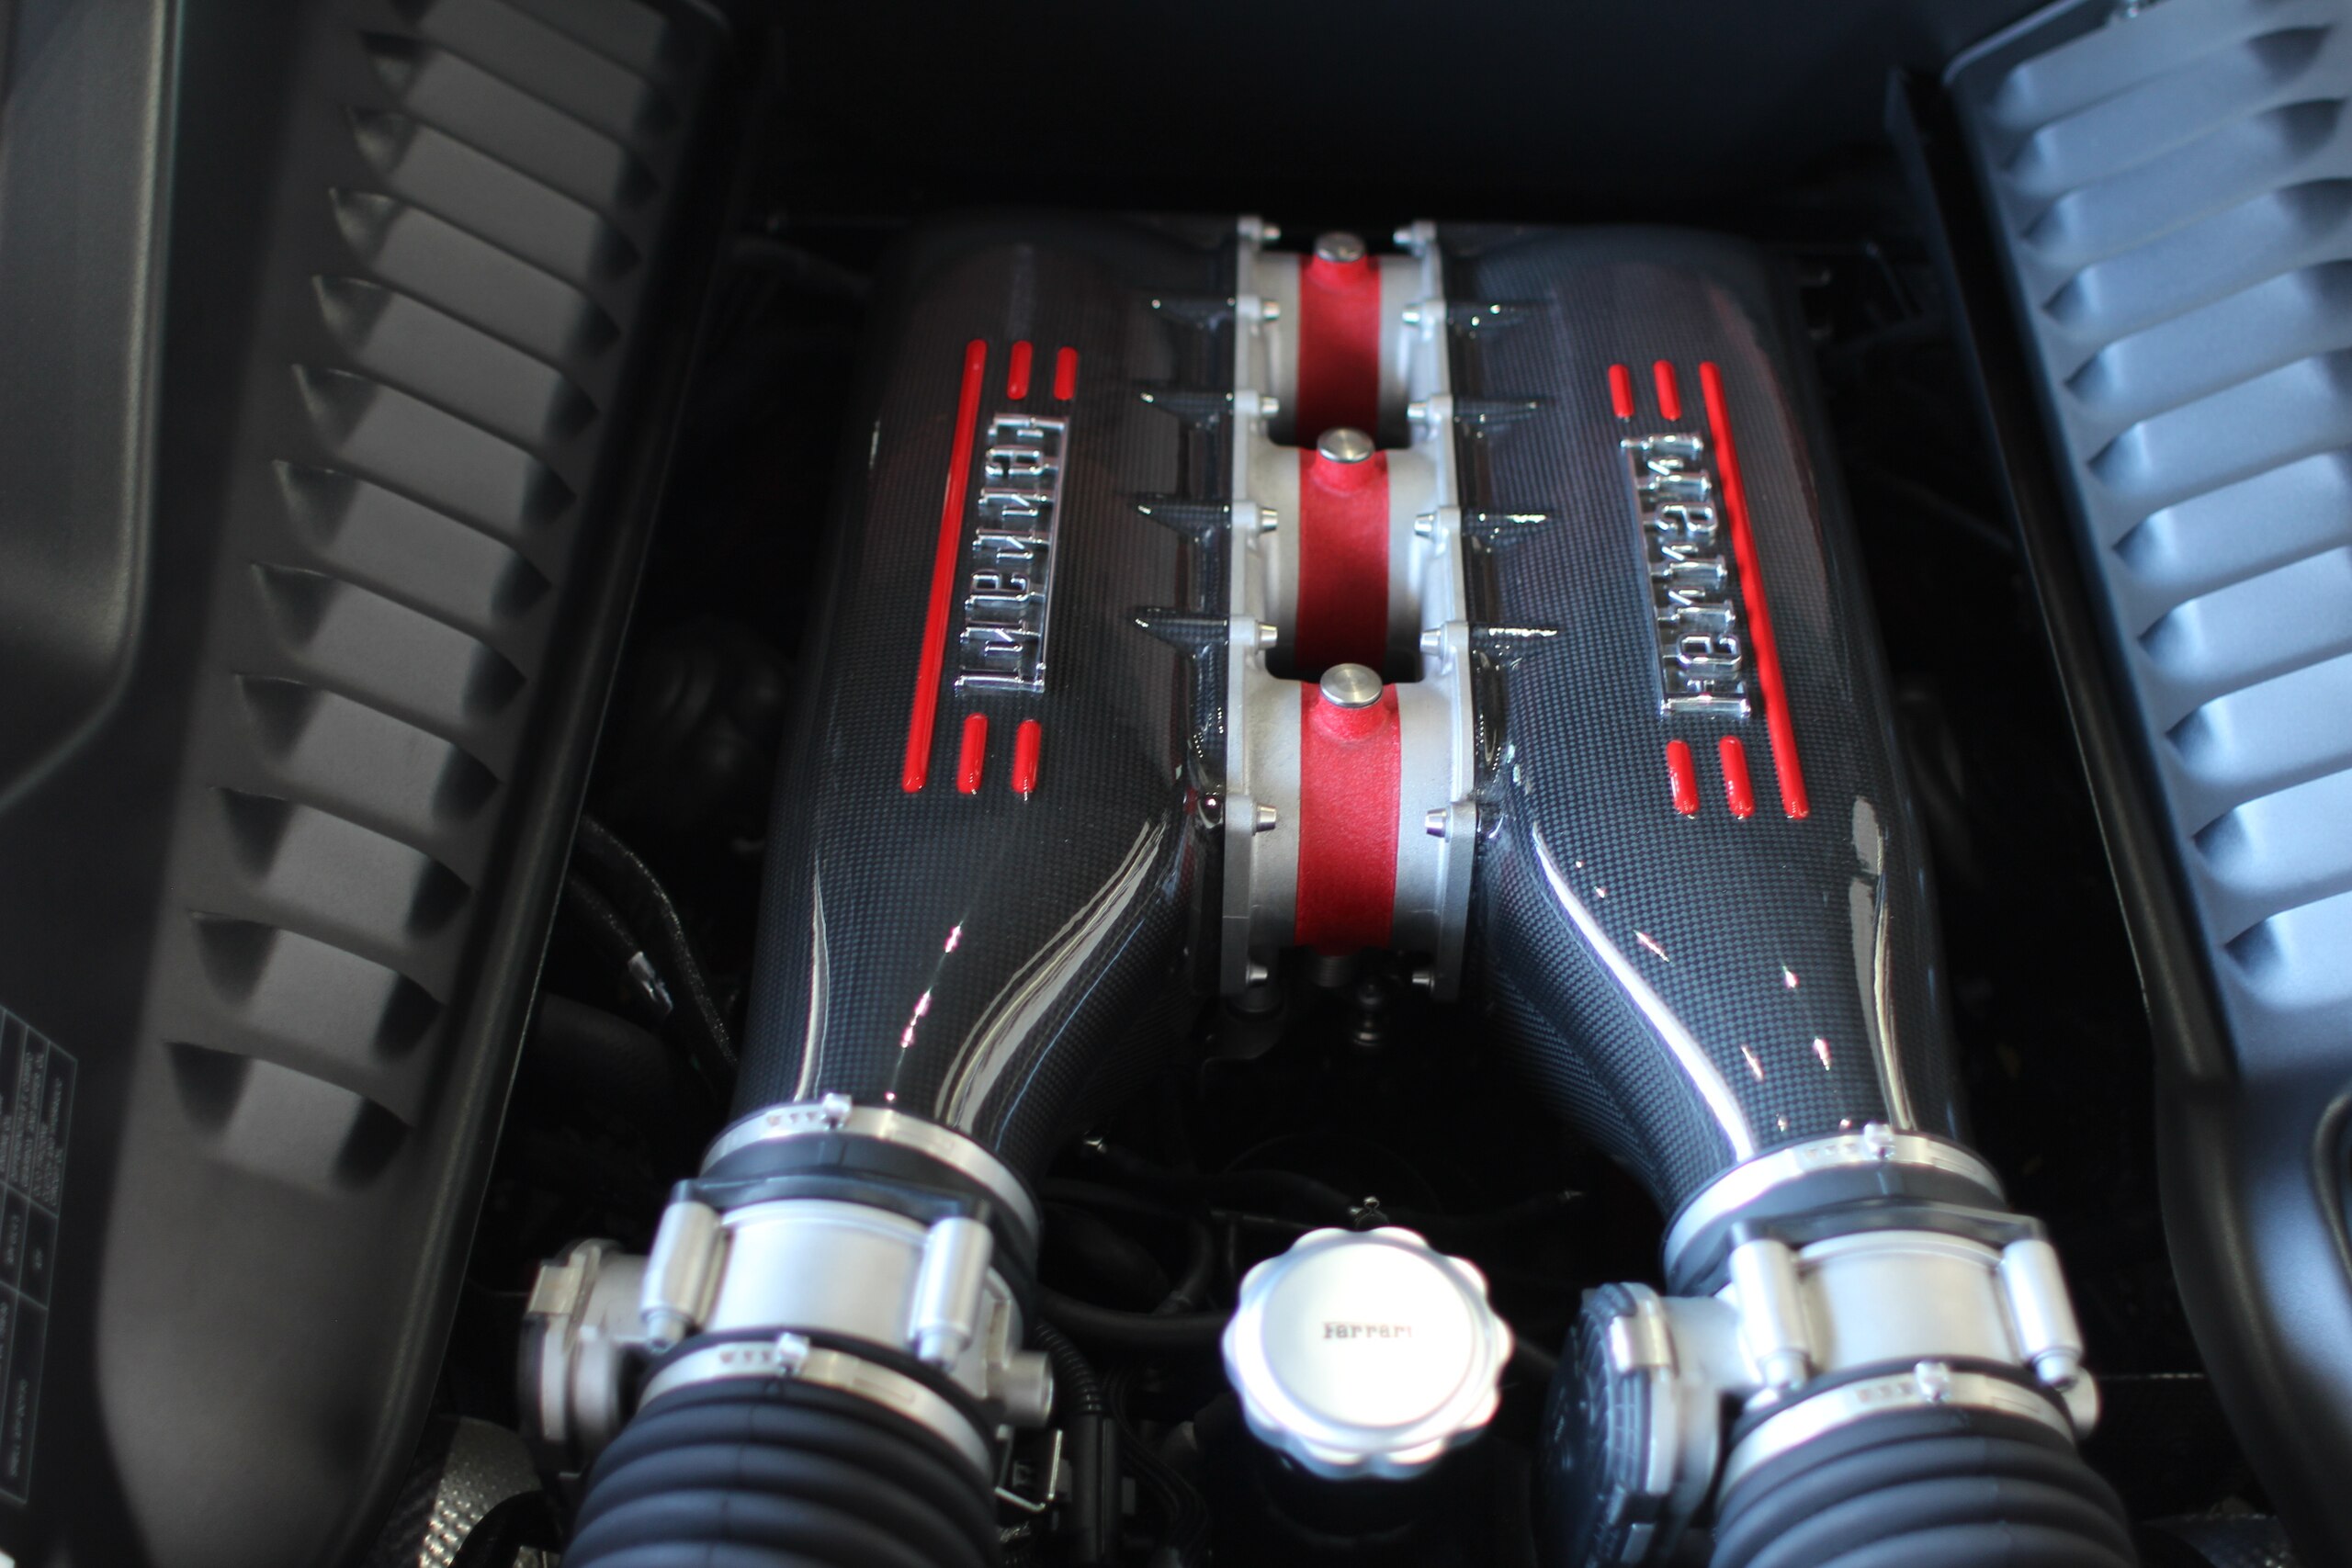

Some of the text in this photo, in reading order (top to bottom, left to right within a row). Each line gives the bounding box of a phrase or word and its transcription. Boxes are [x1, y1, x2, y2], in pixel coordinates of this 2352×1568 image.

[955, 416, 1069, 696] Ferrari
[1620, 433, 1751, 719] Ferrari
[1322, 1321, 1413, 1340] Ferrari
